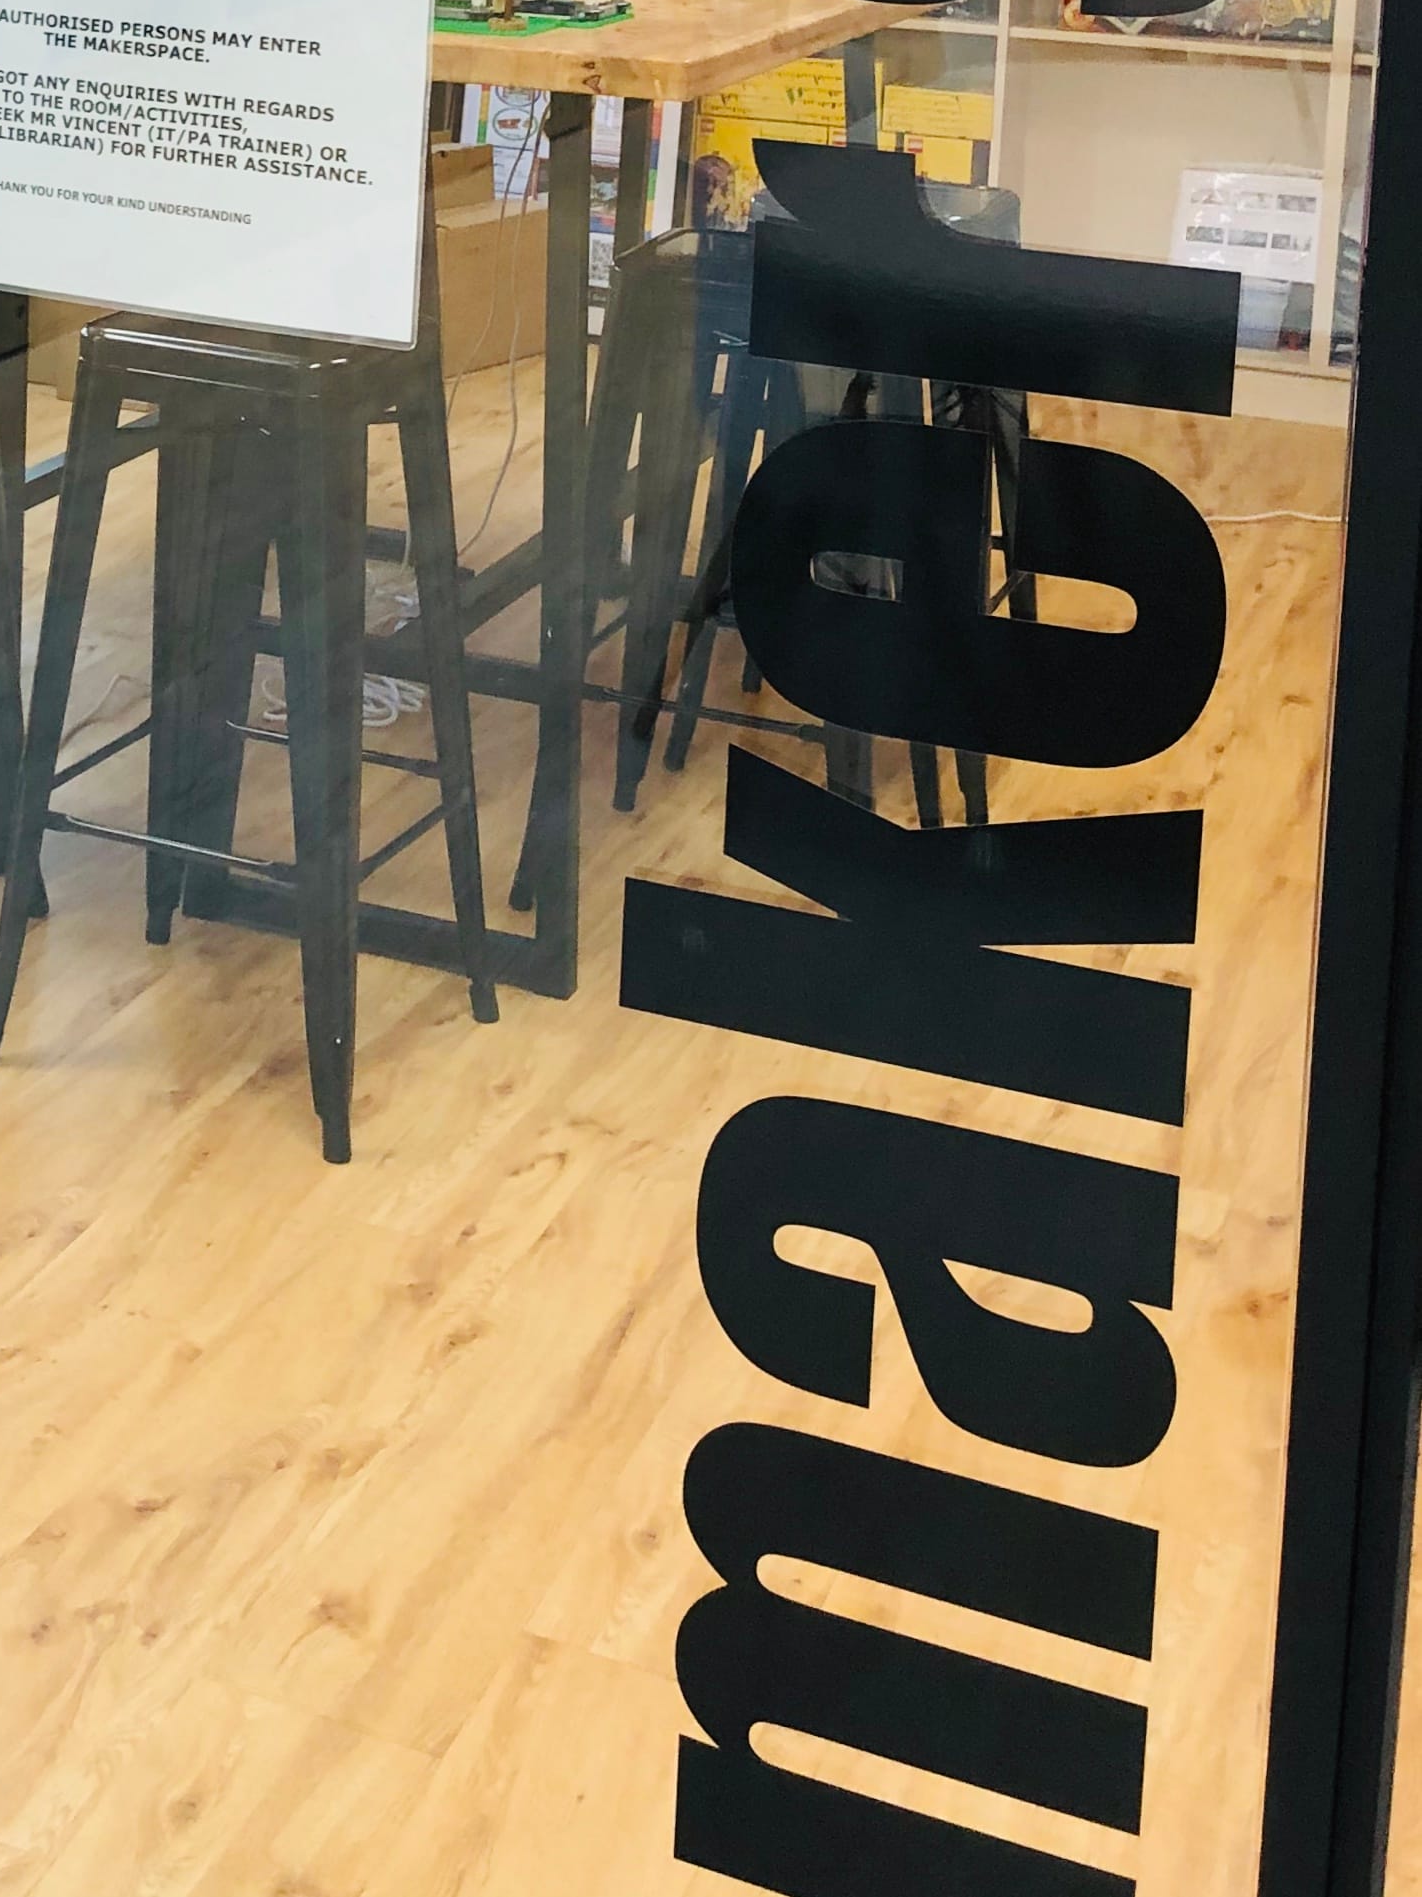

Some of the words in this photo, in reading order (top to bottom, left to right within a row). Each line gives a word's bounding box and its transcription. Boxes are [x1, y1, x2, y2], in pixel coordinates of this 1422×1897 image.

[43, 32, 77, 48] THE
[83, 36, 210, 63] MAKERSPACE.
[120, 21, 206, 44] PERSONS
[212, 31, 253, 48] MAY
[259, 36, 321, 56] ENTER
[2, 88, 24, 105] TO
[30, 92, 64, 110] THE
[70, 97, 248, 134] ROOM/ACTIVITIES,
[34, 74, 70, 91] ANY
[76, 79, 178, 104] ENQUIRIES
[184, 91, 236, 111] WITH
[243, 98, 335, 122] REGARDS
[31, 111, 57, 128] MR
[62, 115, 142, 138] VINCENT
[147, 125, 212, 148] (IT/PA
[218, 134, 313, 162] TRAINER)
[320, 146, 348, 163] OR
[110, 140, 146, 159] FOR
[152, 145, 238, 170] FURTHER
[244, 157, 374, 186] ASSISTANCE.
[30, 184, 55, 198] YOU
[57, 188, 80, 202] FOR
[82, 192, 114, 207] YOUR
[117, 196, 146, 211] KIND
[148, 200, 252, 225] UNDERSTANDING
